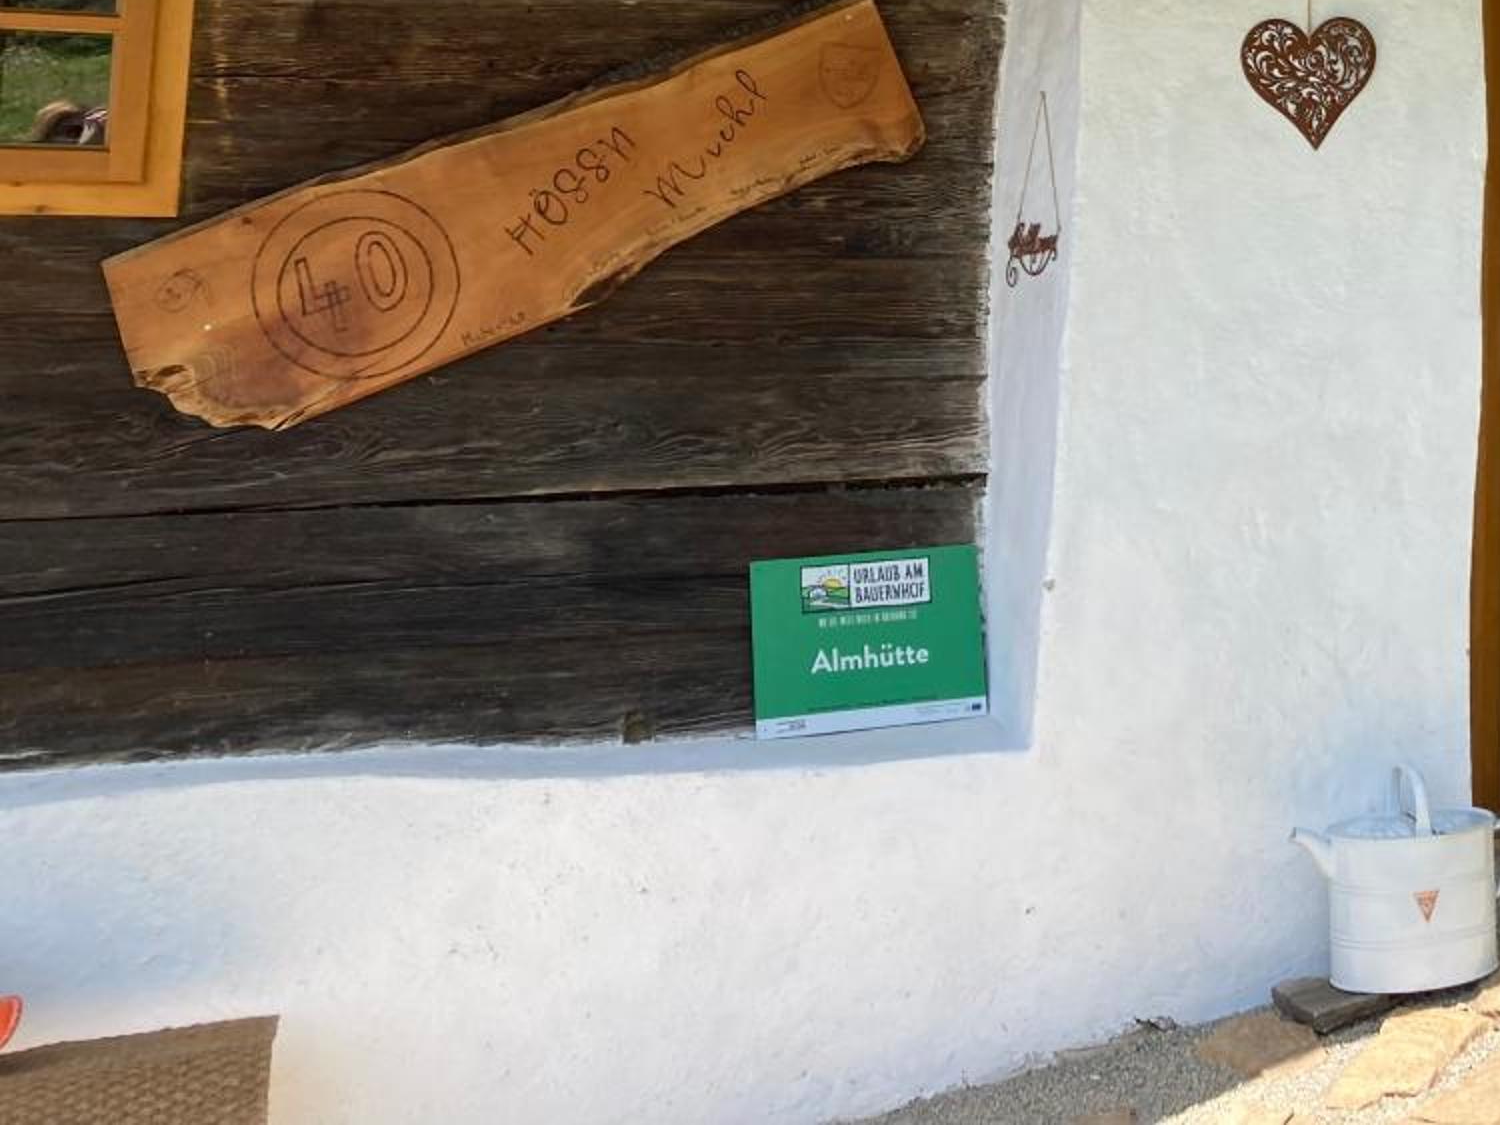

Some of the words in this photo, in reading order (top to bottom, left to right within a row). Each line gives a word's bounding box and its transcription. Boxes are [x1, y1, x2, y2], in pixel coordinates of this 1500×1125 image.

[293, 230, 409, 334] 40
[852, 565, 900, 584] URLAUB
[905, 561, 923, 579] AM
[855, 582, 925, 603] BAUERNHOF
[811, 643, 929, 674] Almhütte
